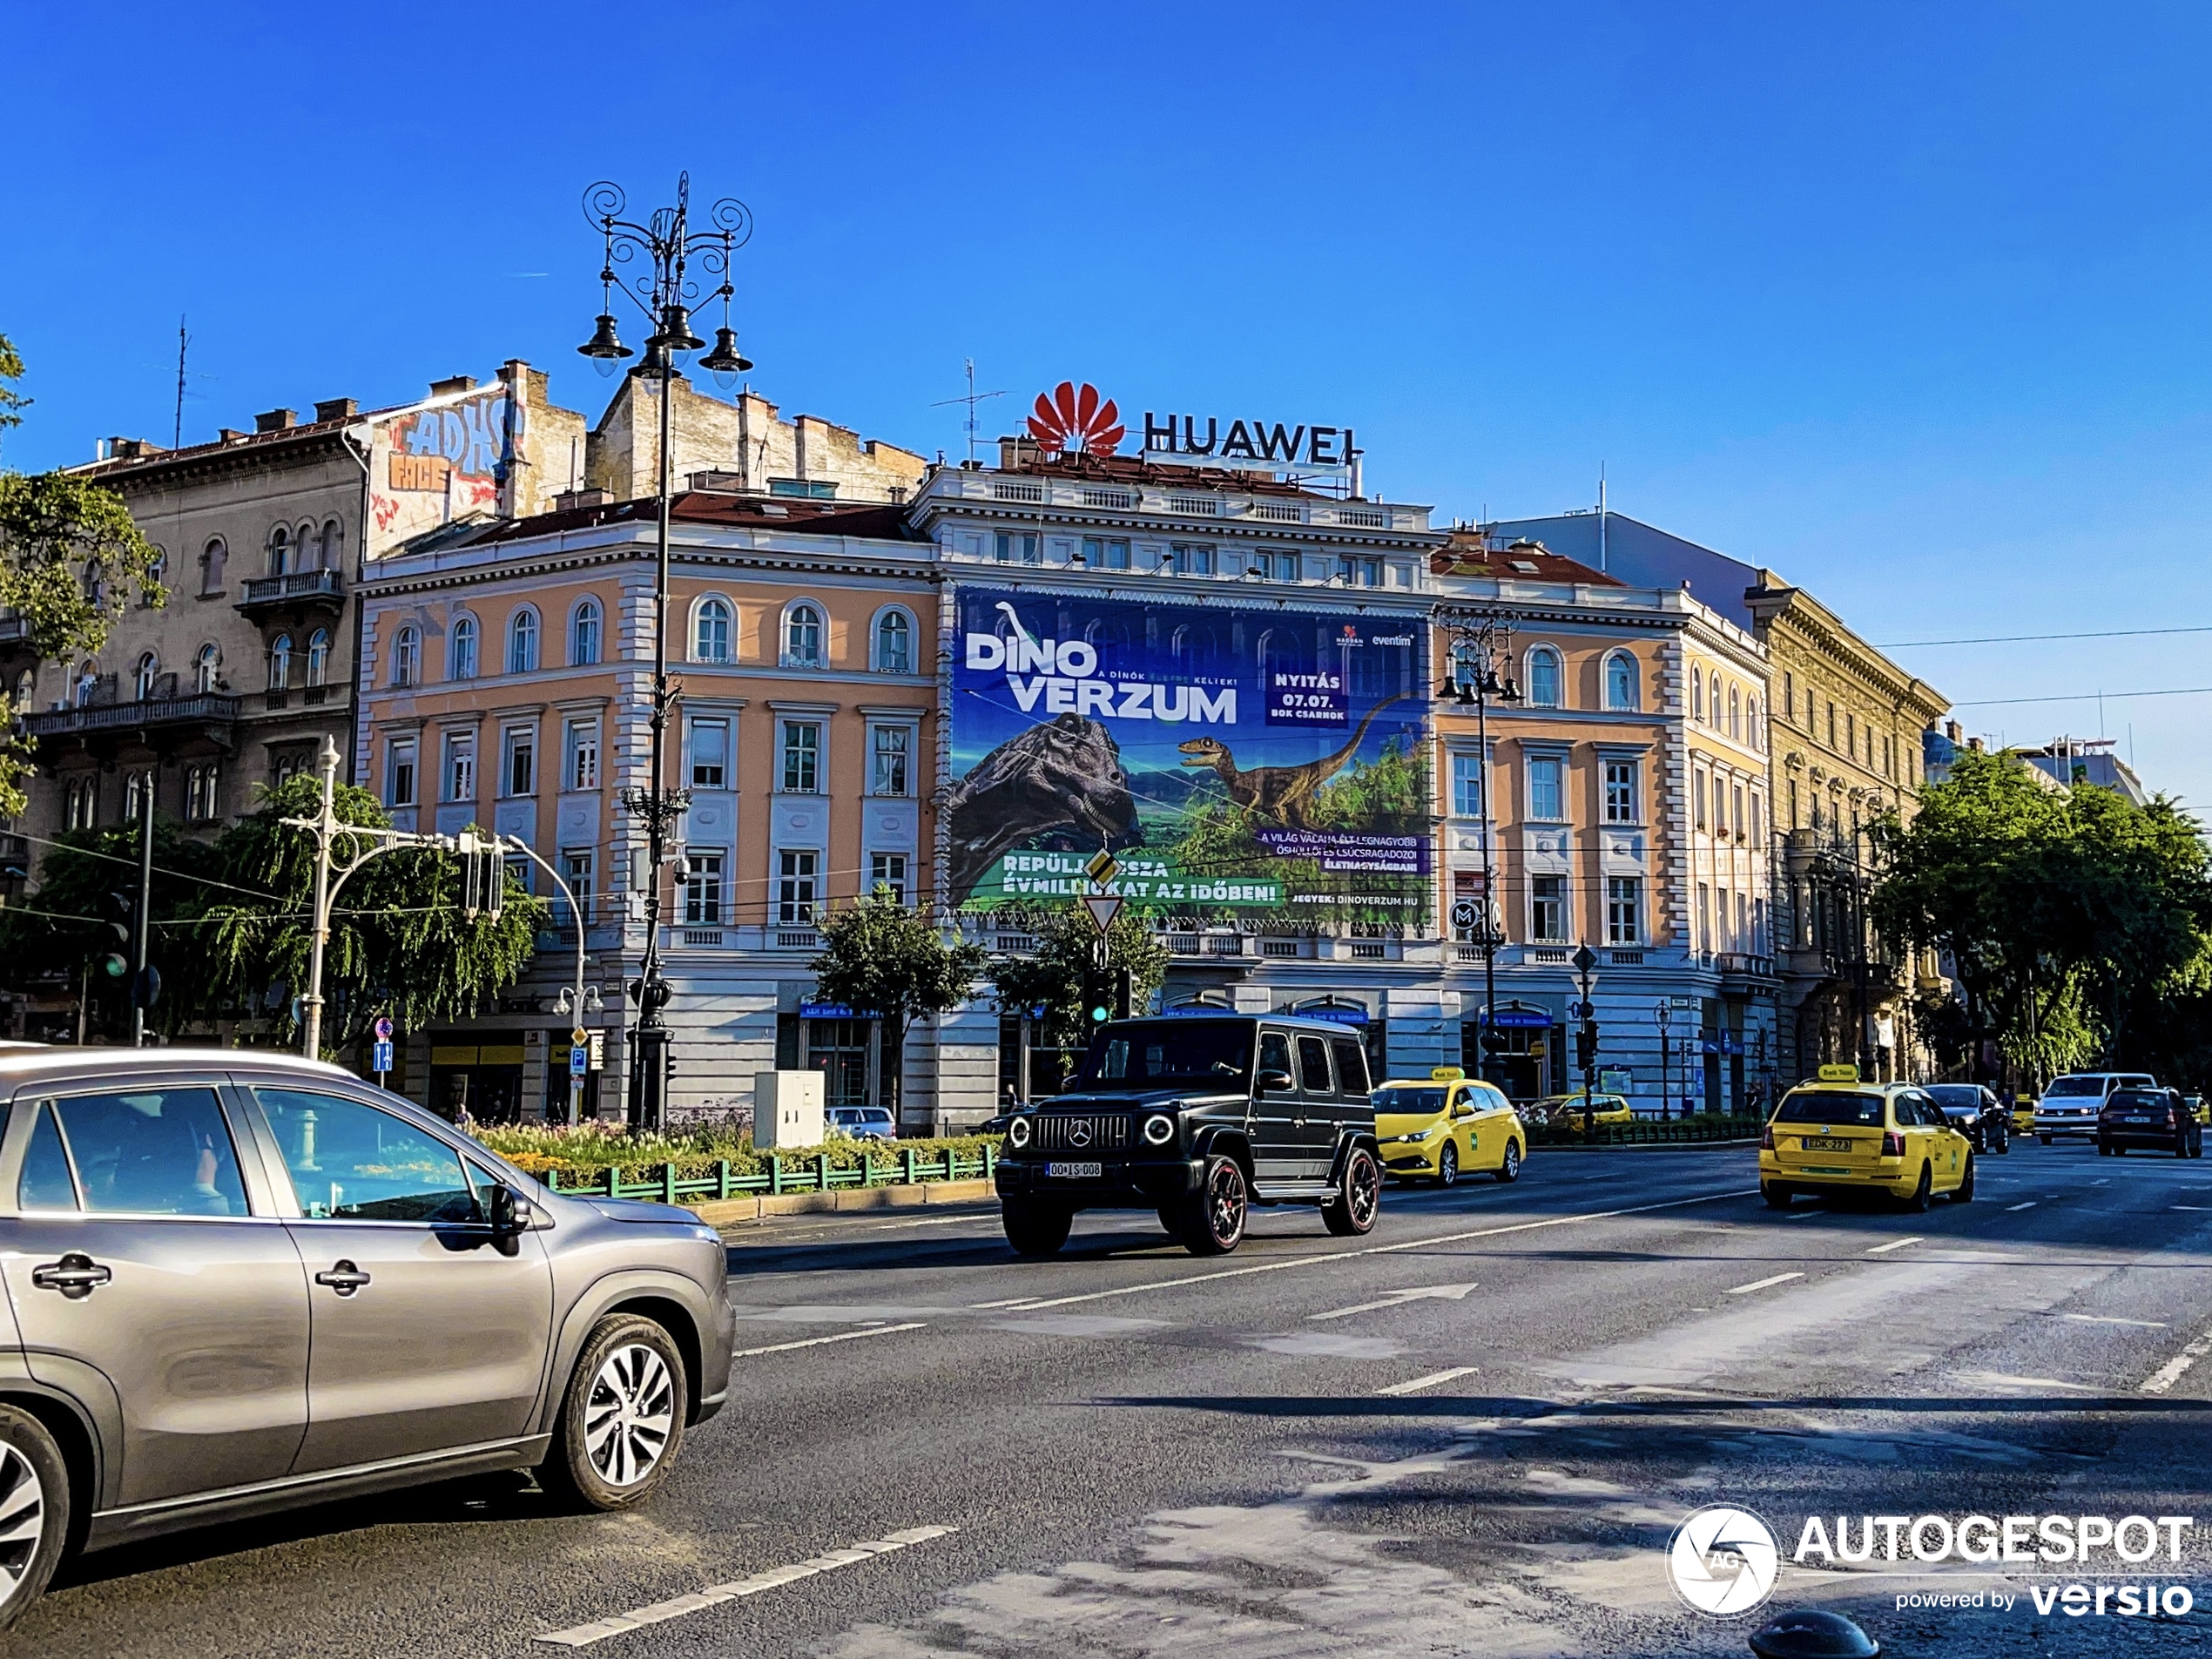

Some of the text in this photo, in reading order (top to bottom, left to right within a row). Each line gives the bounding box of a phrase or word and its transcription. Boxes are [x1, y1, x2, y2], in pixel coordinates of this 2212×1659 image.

[1145, 412, 1352, 466] HUAWEI
[391, 455, 450, 493] FACE
[1372, 634, 1411, 646] eventim
[966, 633, 1097, 678] DINO
[1109, 670, 1145, 680] DÍNÓK
[1194, 677, 1238, 686] KELTEK!
[1275, 672, 1340, 689] NYITÁS
[1006, 674, 1237, 724] VERZUM
[1282, 694, 1333, 708] 07.07.
[1271, 709, 1345, 720] BOK CSARNOK
[1271, 832, 1298, 843] VILÁG
[1357, 836, 1417, 846] LEGNAGYOBB
[1003, 853, 1084, 873] REPÜLJ
[1156, 883, 1184, 899] AZ
[1190, 880, 1276, 901] IDŐBEN!
[1291, 894, 1335, 904] JEGYEK:
